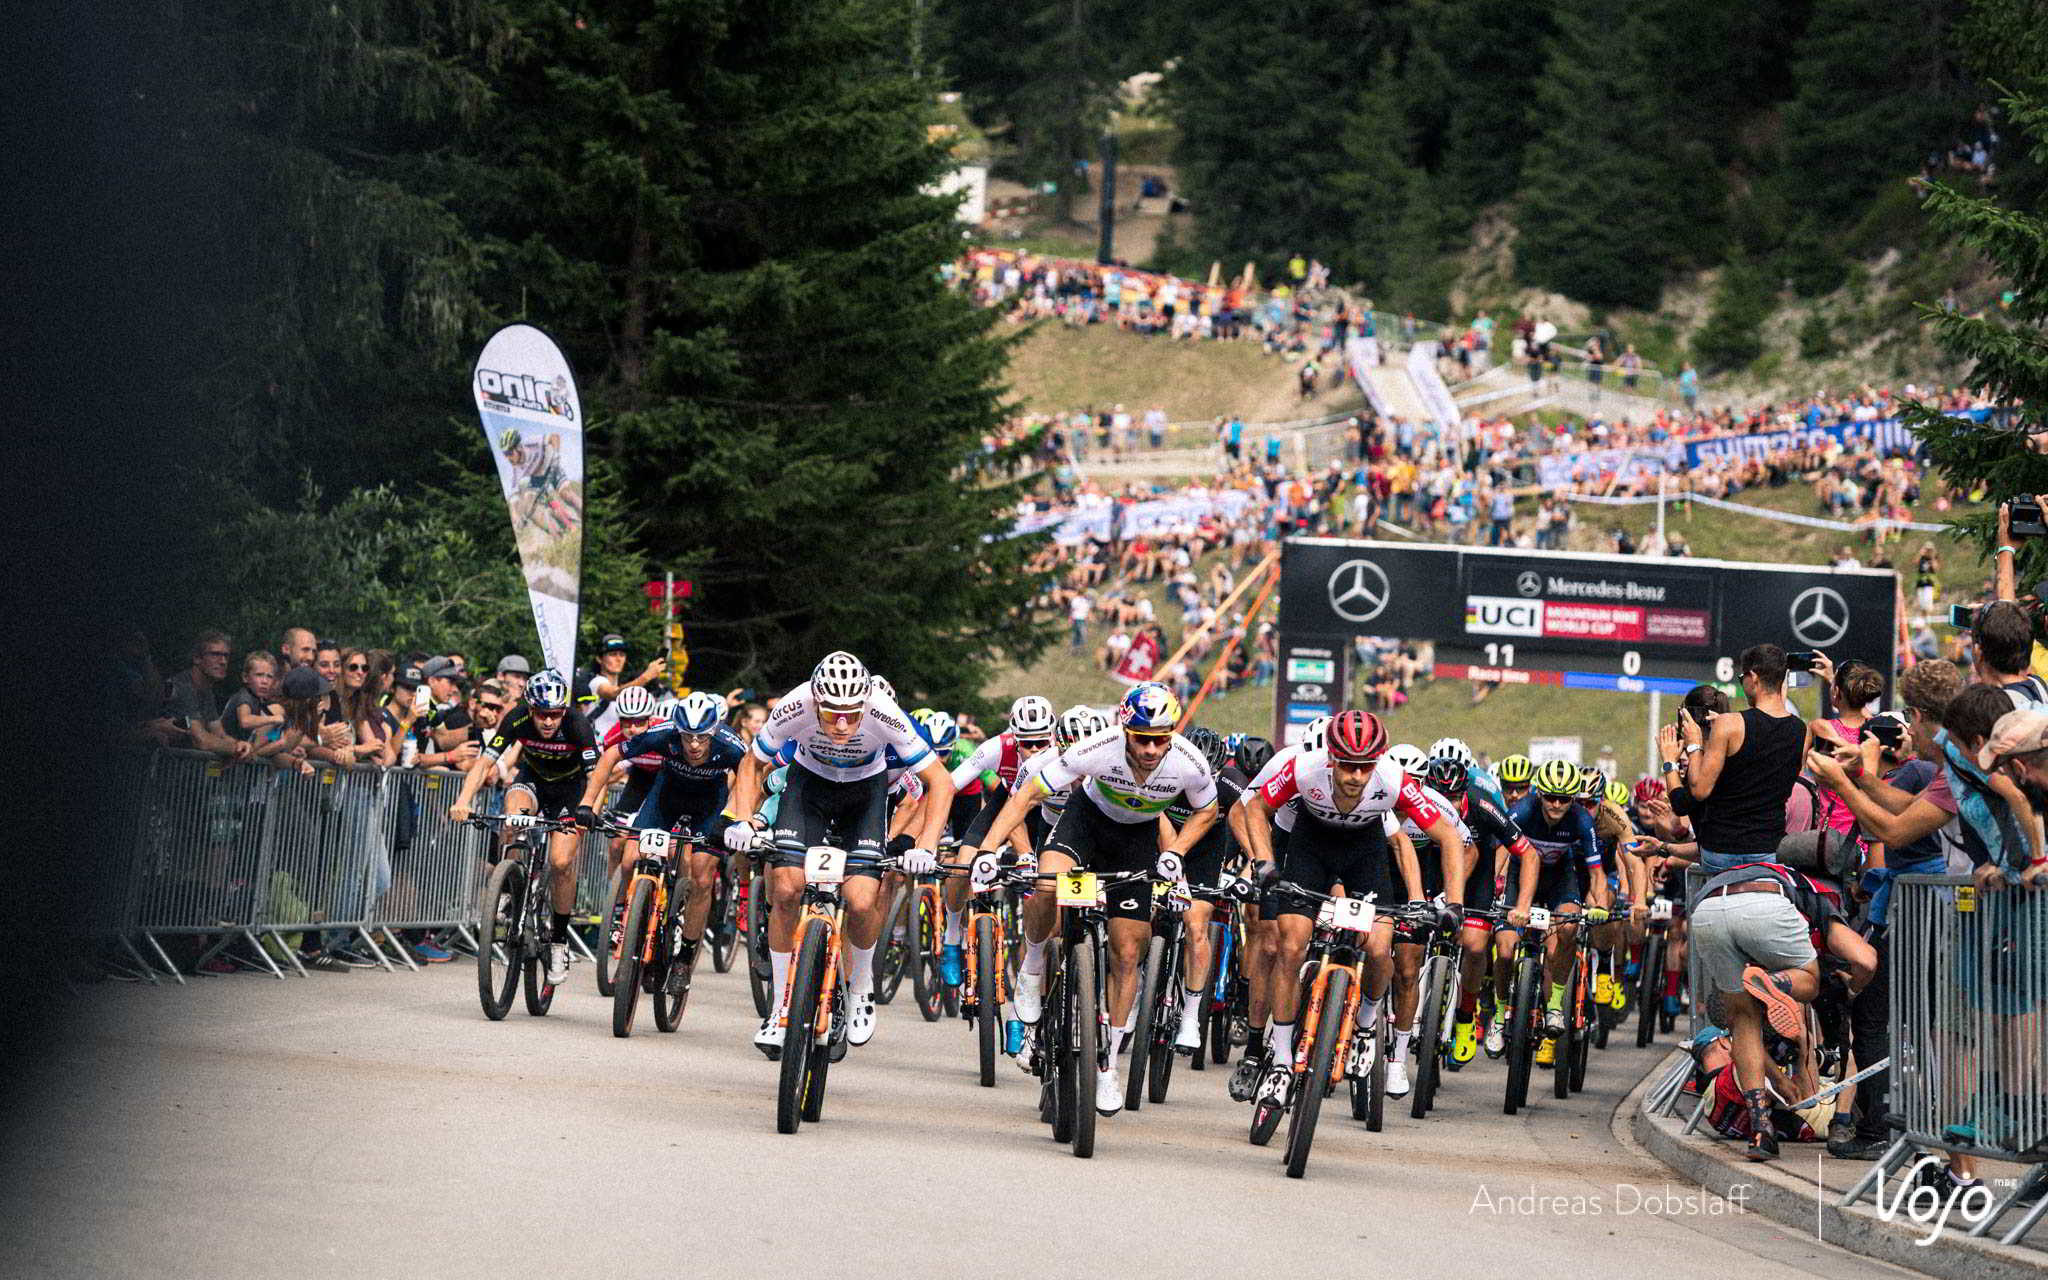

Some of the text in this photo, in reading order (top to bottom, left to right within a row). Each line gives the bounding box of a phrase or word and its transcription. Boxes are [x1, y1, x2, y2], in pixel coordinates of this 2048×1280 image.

[1547, 576, 1666, 601] Mercedes-Benz
[1481, 605, 1535, 628] UCI
[1485, 643, 1515, 667] 11
[1622, 650, 1641, 675] 0
[1715, 656, 1734, 682] 6
[772, 699, 803, 721] Circus
[869, 707, 906, 731] corendon
[1077, 734, 1120, 756] cannondale
[1220, 775, 1245, 794] cannon
[647, 832, 665, 847] 15
[817, 853, 832, 871] 2
[1071, 880, 1082, 895] 3
[1349, 901, 1361, 916] 9
